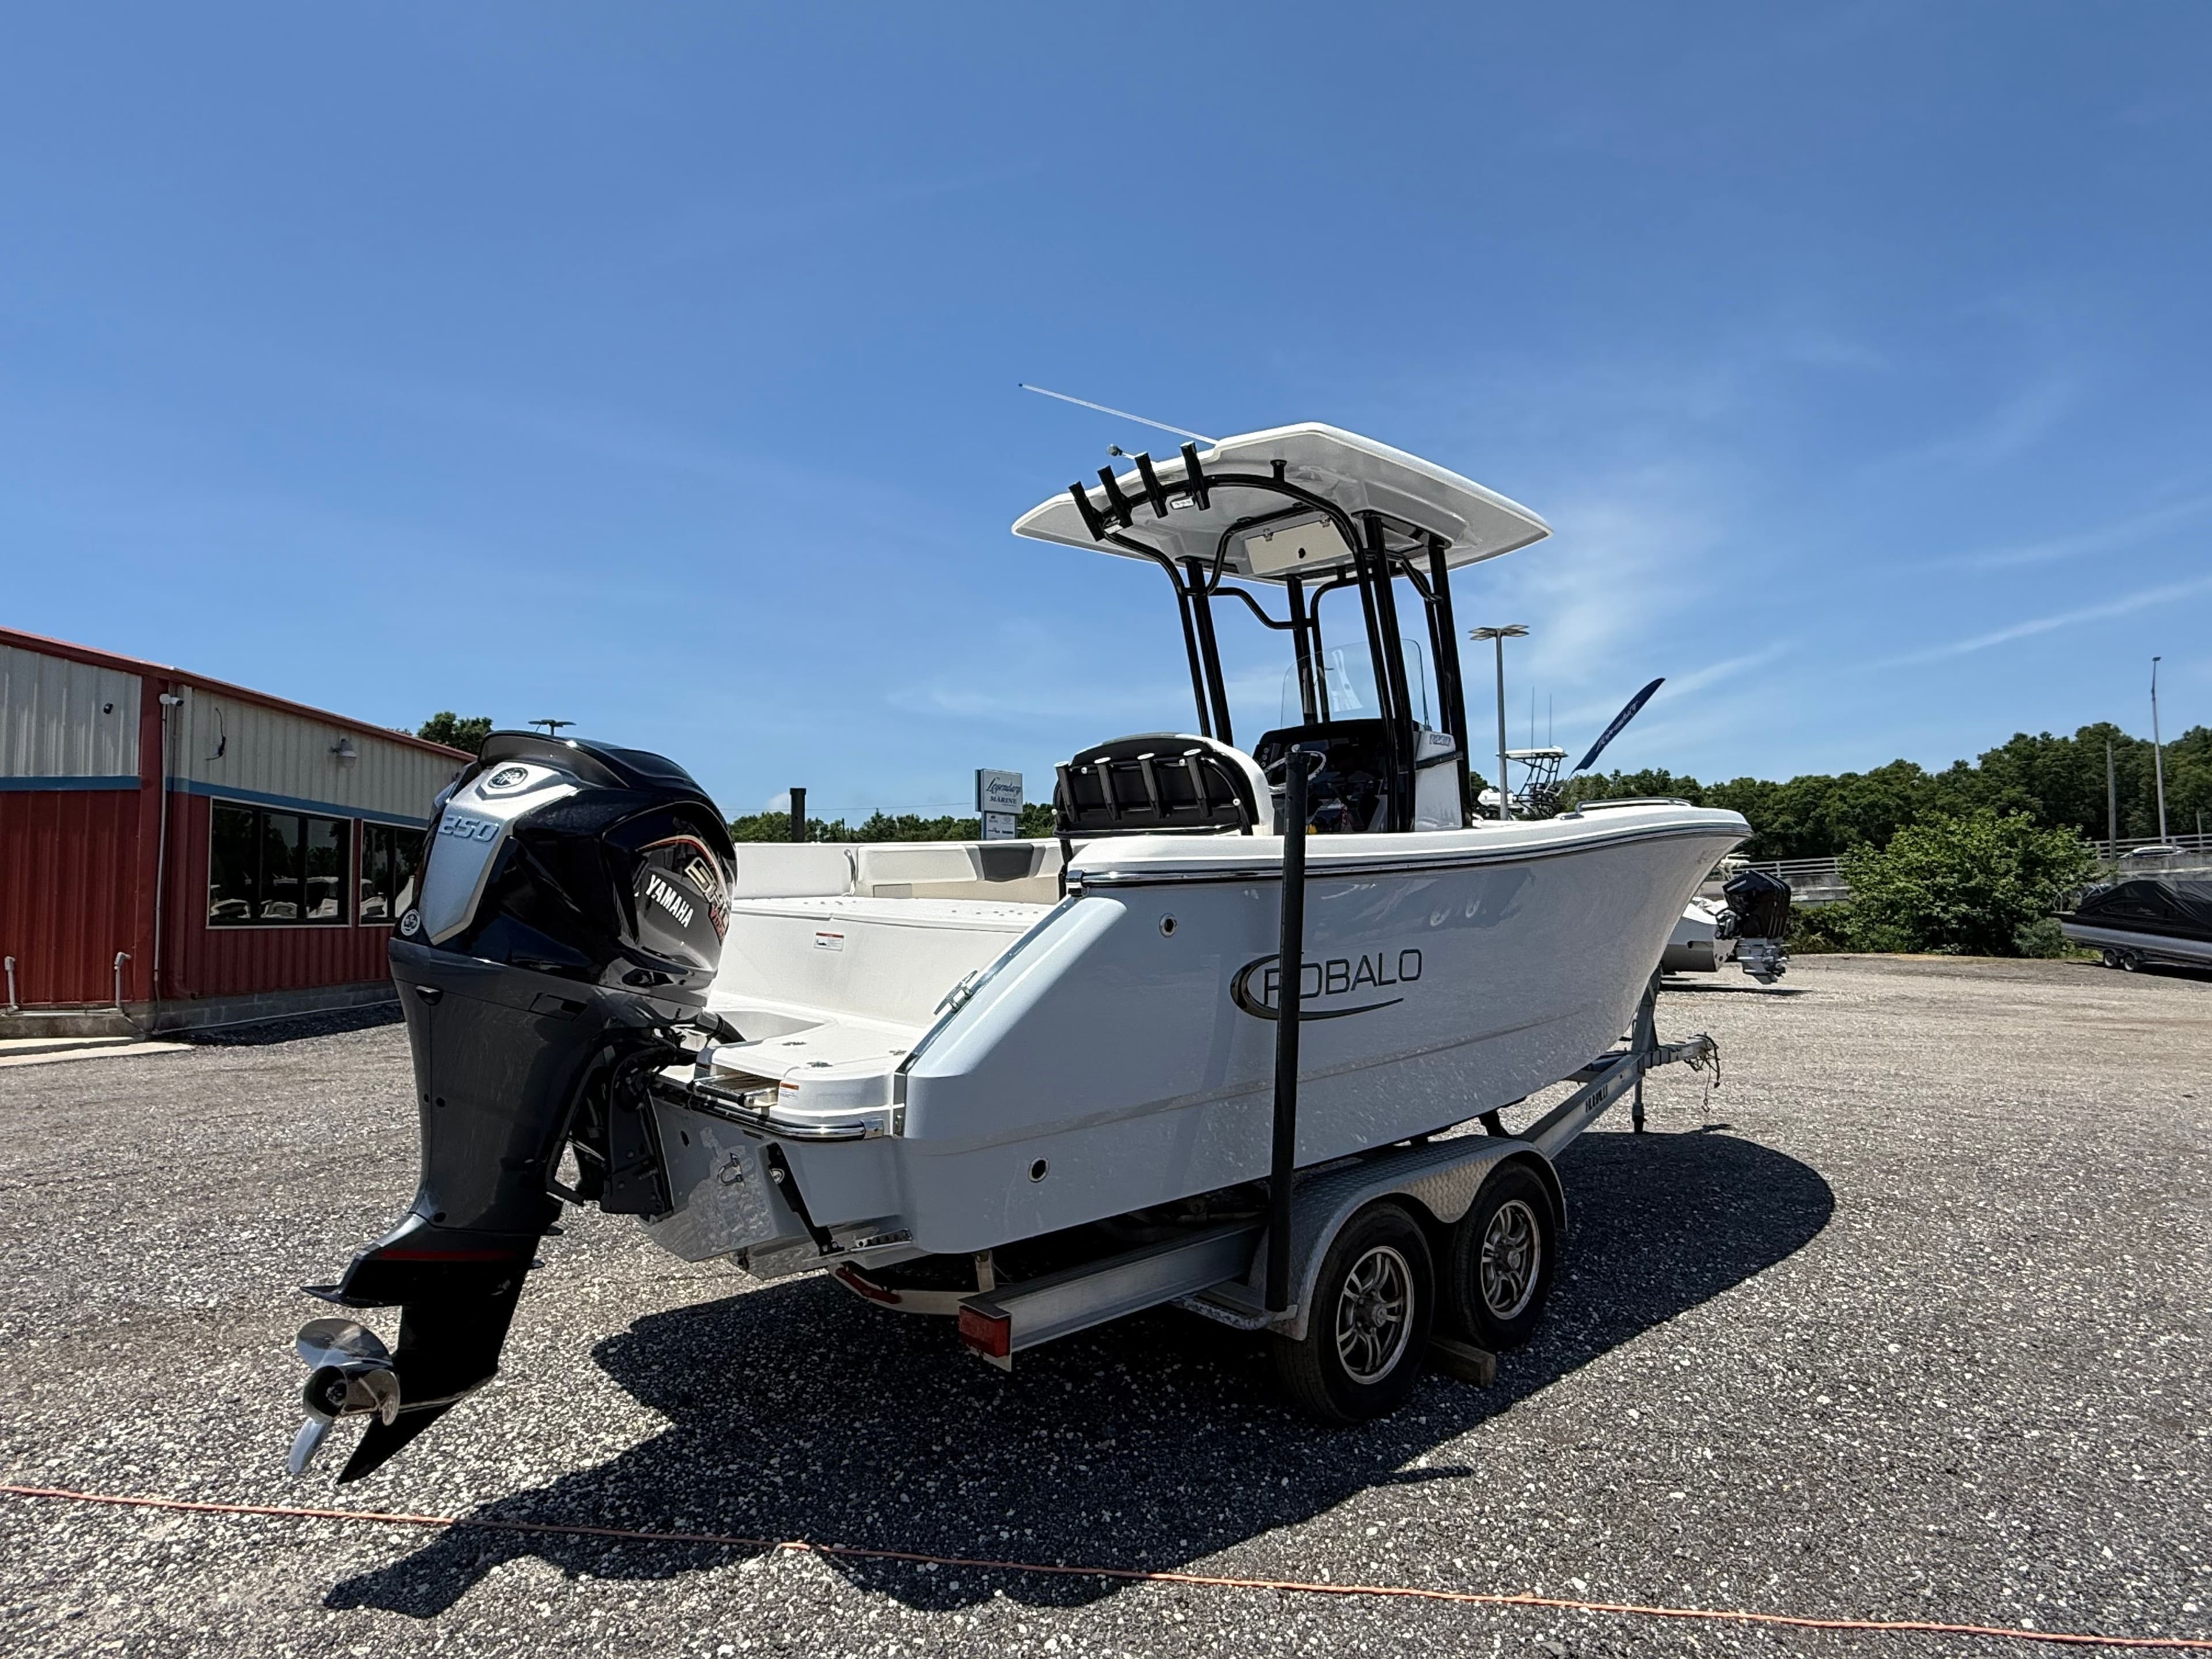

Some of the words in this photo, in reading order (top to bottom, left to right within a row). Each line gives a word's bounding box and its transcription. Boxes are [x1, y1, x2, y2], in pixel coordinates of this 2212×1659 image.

[986, 777, 1022, 797] Legendary
[990, 796, 1017, 805] MARINE
[438, 815, 499, 842] 250
[645, 874, 694, 928] YAMAHA
